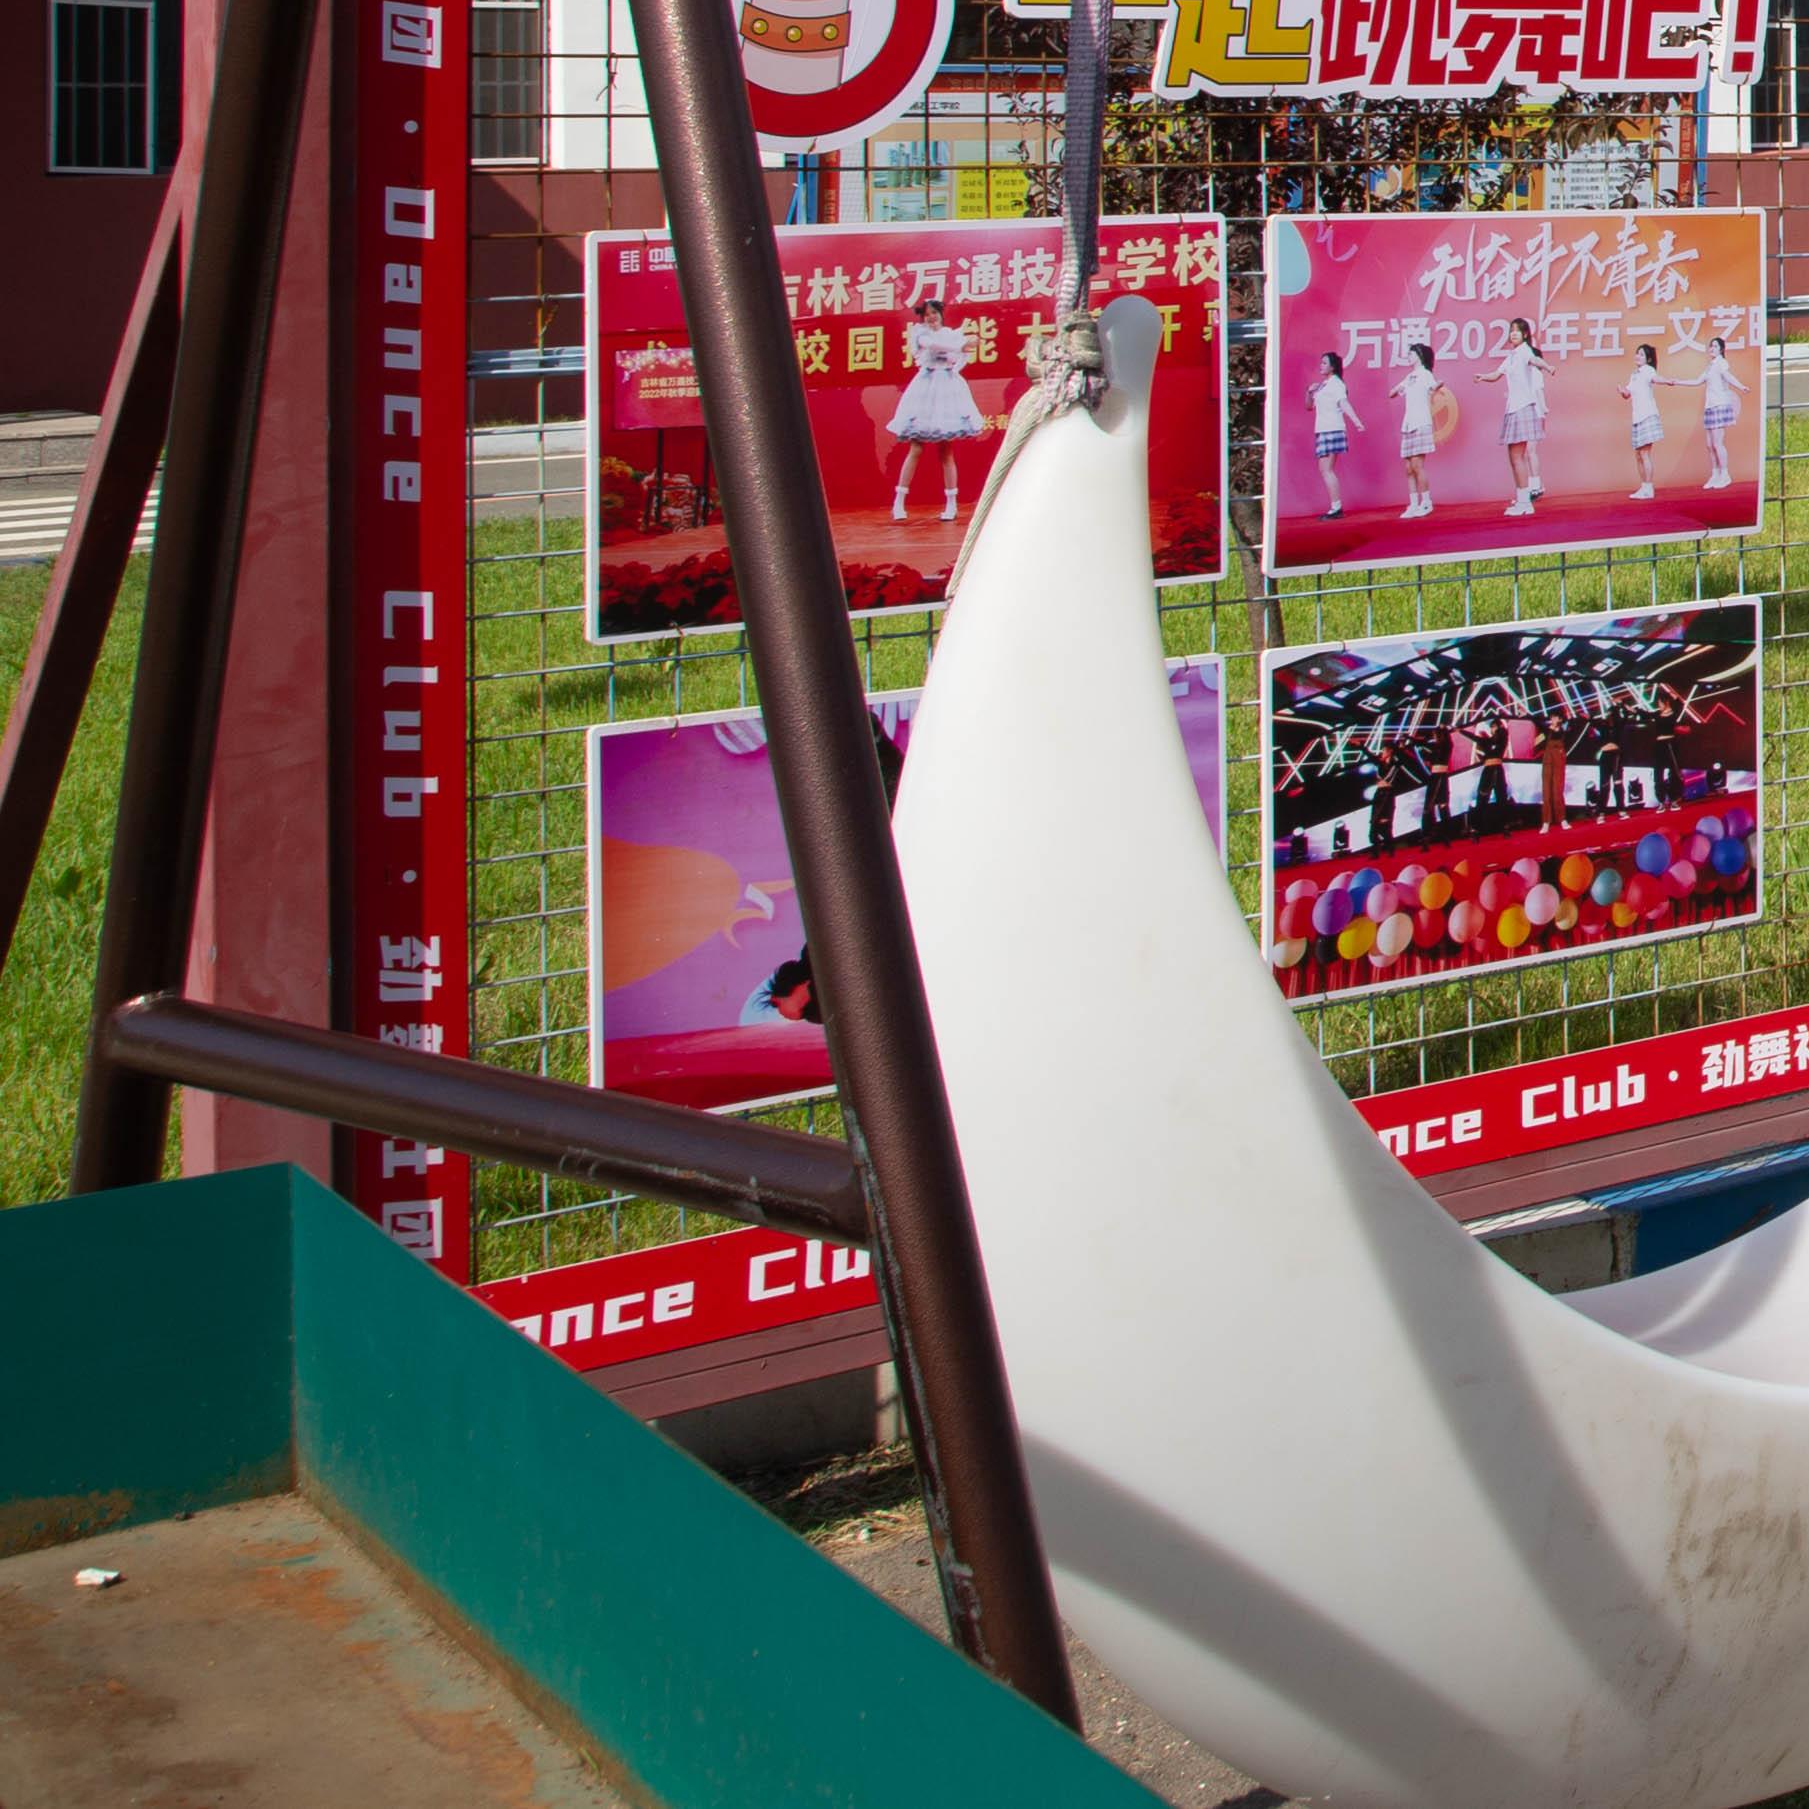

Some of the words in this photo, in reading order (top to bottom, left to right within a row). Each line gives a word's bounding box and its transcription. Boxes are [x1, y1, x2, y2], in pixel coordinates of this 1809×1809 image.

[384, 186, 435, 504] Dance
[383, 590, 438, 818] Club
[1522, 1063, 1646, 1129] Club
[749, 1239, 871, 1302] Clu
